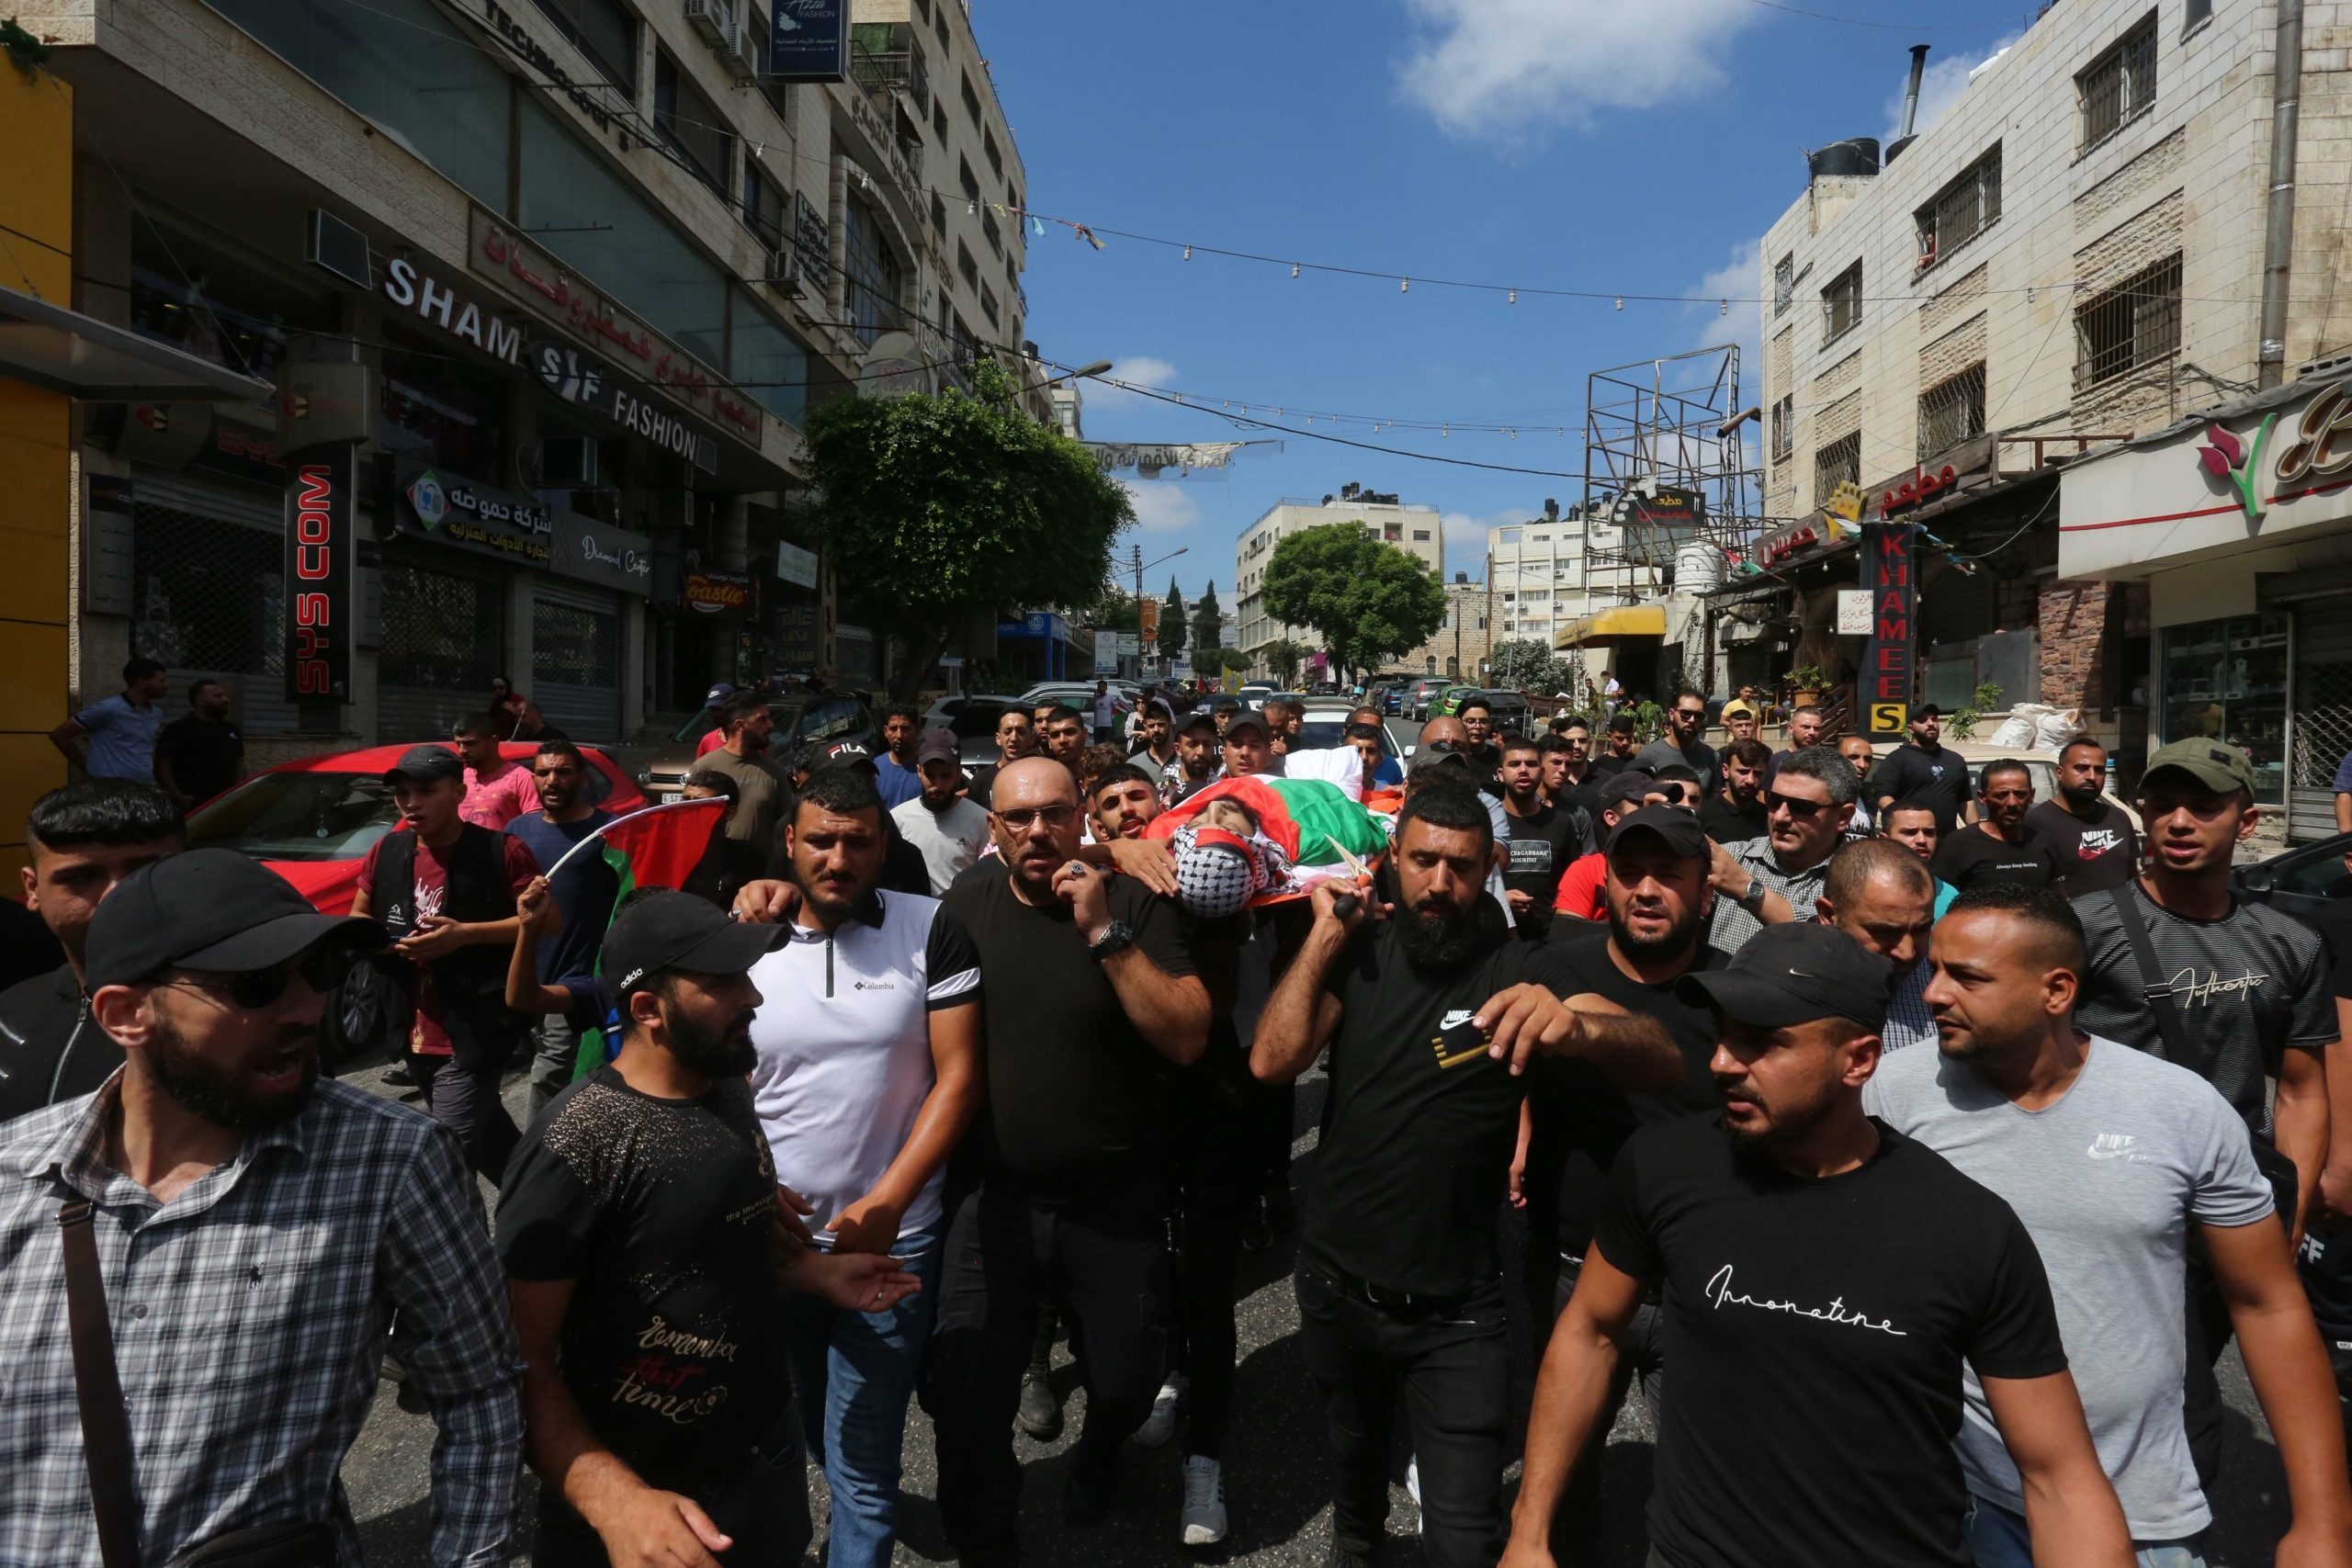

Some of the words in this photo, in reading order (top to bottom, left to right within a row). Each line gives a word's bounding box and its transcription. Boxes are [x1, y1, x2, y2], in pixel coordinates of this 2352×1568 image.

[800, 9, 835, 18] FASHION
[384, 257, 521, 367] SHAM
[614, 389, 698, 462] FASHION
[1651, 494, 1682, 507] مطعم
[1880, 464, 1959, 521] مطعم
[298, 465, 332, 580] COM
[514, 505, 551, 535] شركة
[582, 534, 621, 570] Diamond
[625, 550, 650, 577] Center
[297, 592, 330, 694] SYS
[1876, 534, 1907, 732] KHAMEES
[829, 742, 867, 759] FILA
[2082, 829, 2114, 847] NIKE
[864, 981, 895, 990] Columbia
[1445, 1010, 1472, 1021] NIKE
[2095, 1133, 2135, 1150] NIKE
